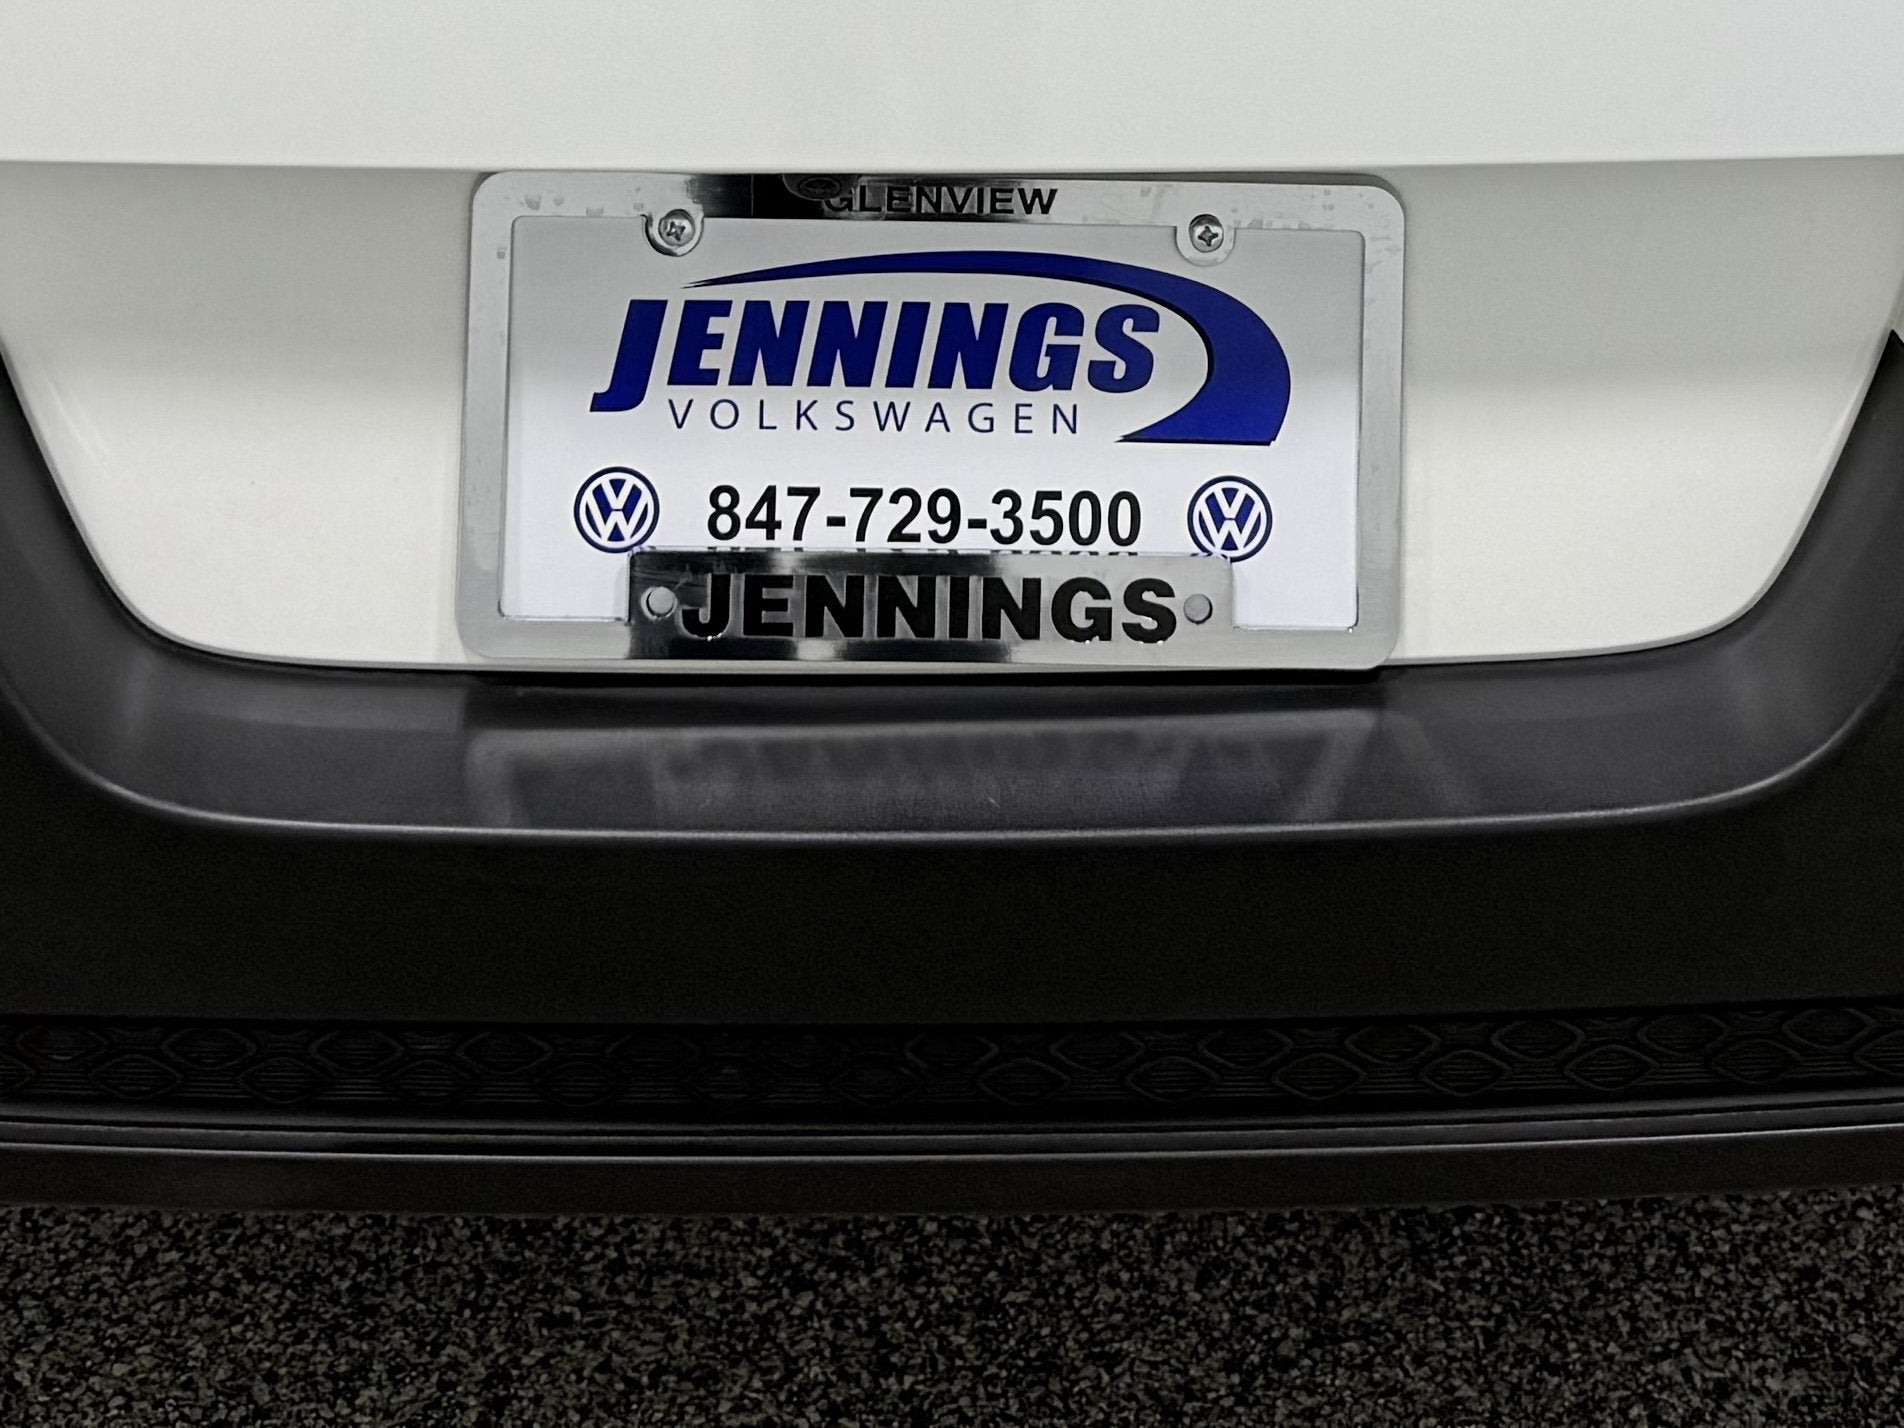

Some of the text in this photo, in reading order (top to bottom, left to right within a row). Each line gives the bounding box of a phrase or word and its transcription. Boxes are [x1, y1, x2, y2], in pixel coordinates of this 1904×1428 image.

[823, 185, 1059, 216] GLENVIEW
[588, 299, 1161, 412] JENNINGS
[668, 398, 1079, 435] VOLKSWAGEN
[706, 484, 1141, 546] 847-729-3500
[681, 573, 1177, 644] JENNINGS
